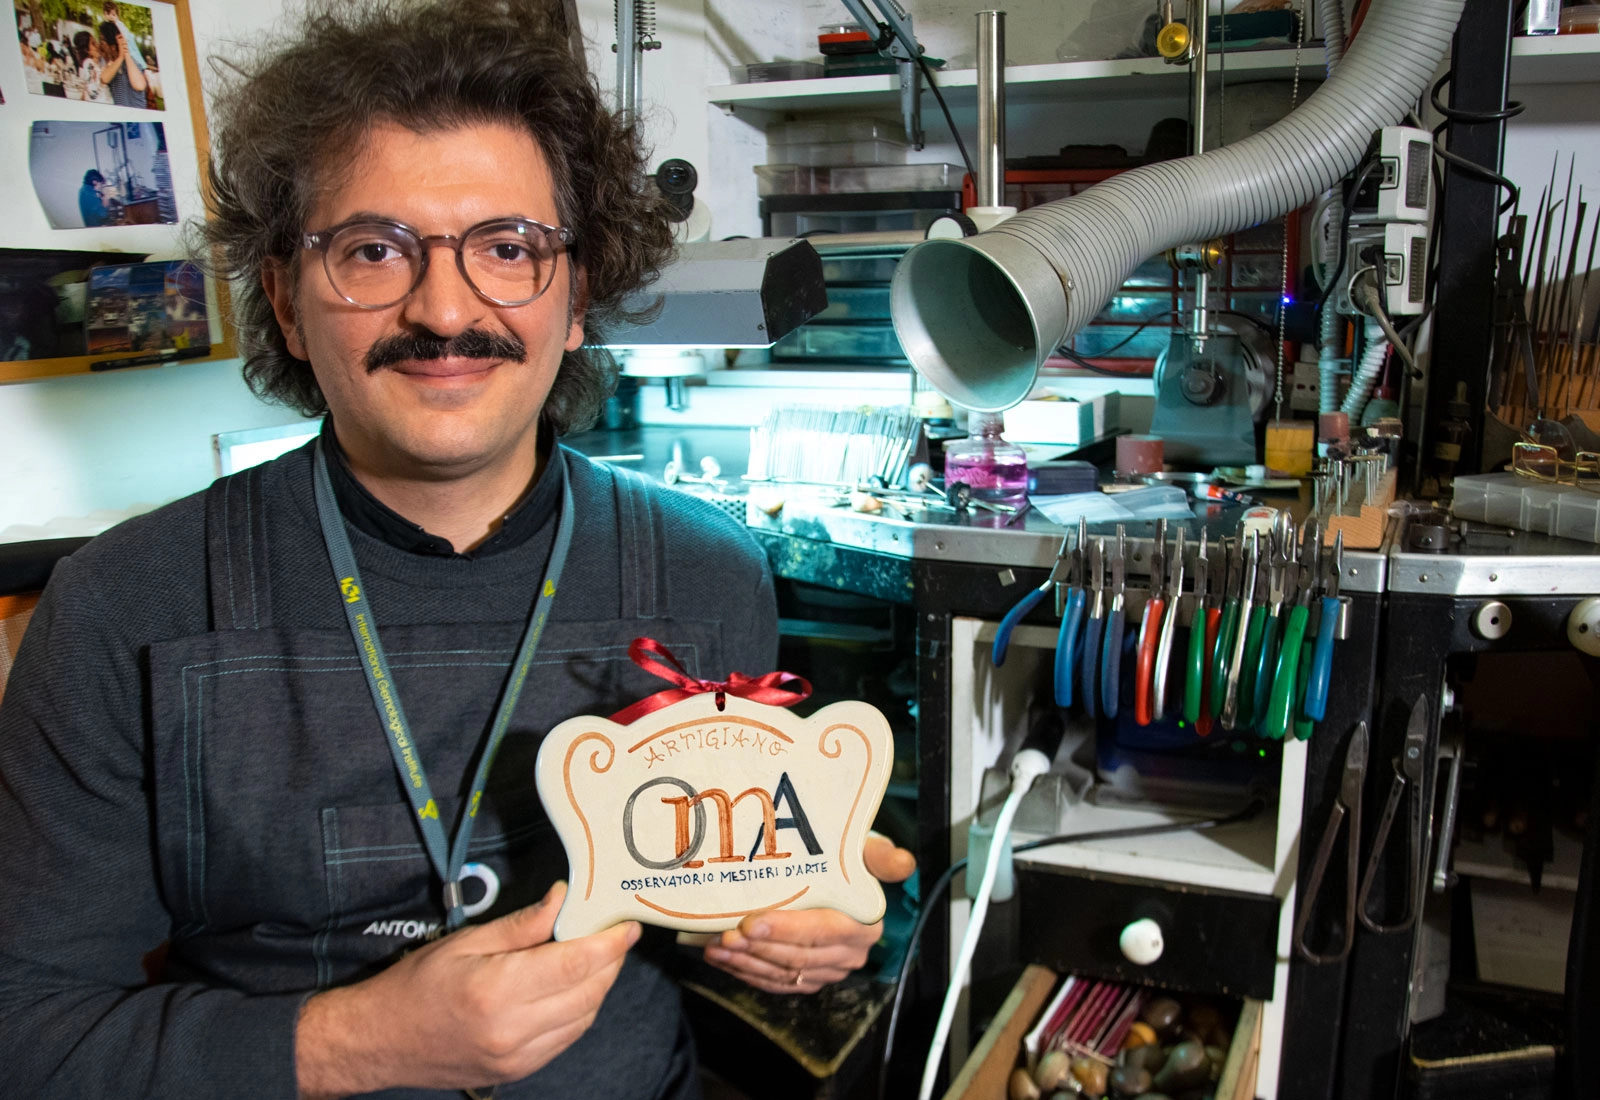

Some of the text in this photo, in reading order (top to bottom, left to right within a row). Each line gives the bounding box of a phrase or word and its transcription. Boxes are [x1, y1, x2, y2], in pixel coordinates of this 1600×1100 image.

[355, 613, 423, 789] International Gemological Institute
[643, 727, 788, 769] ARTIGIANO
[620, 861, 829, 891] OSSERVATORIO MESTIERI D'ARTE
